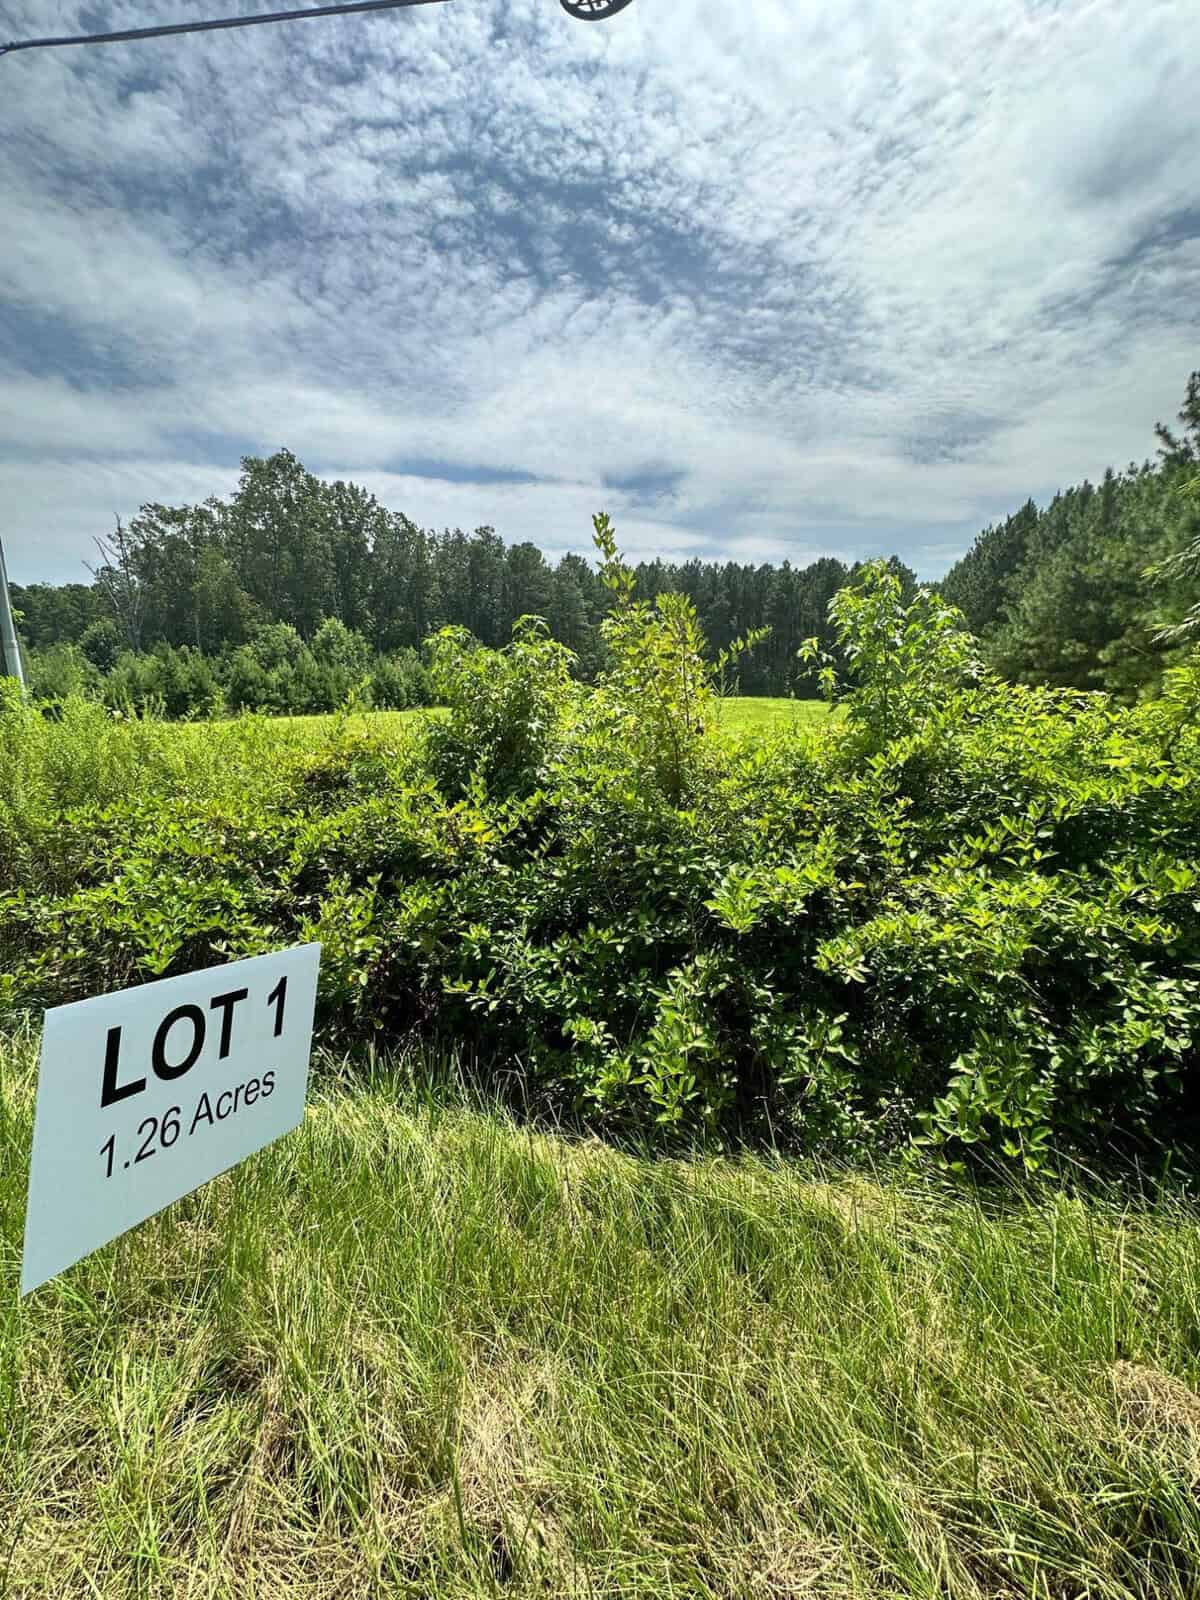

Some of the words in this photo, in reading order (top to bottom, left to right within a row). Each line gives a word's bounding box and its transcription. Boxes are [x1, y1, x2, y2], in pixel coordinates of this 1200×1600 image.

[100, 987, 249, 1108] LOT
[267, 975, 288, 1038] 1
[99, 1106, 181, 1179] 1.26
[189, 1070, 276, 1136] Acres
